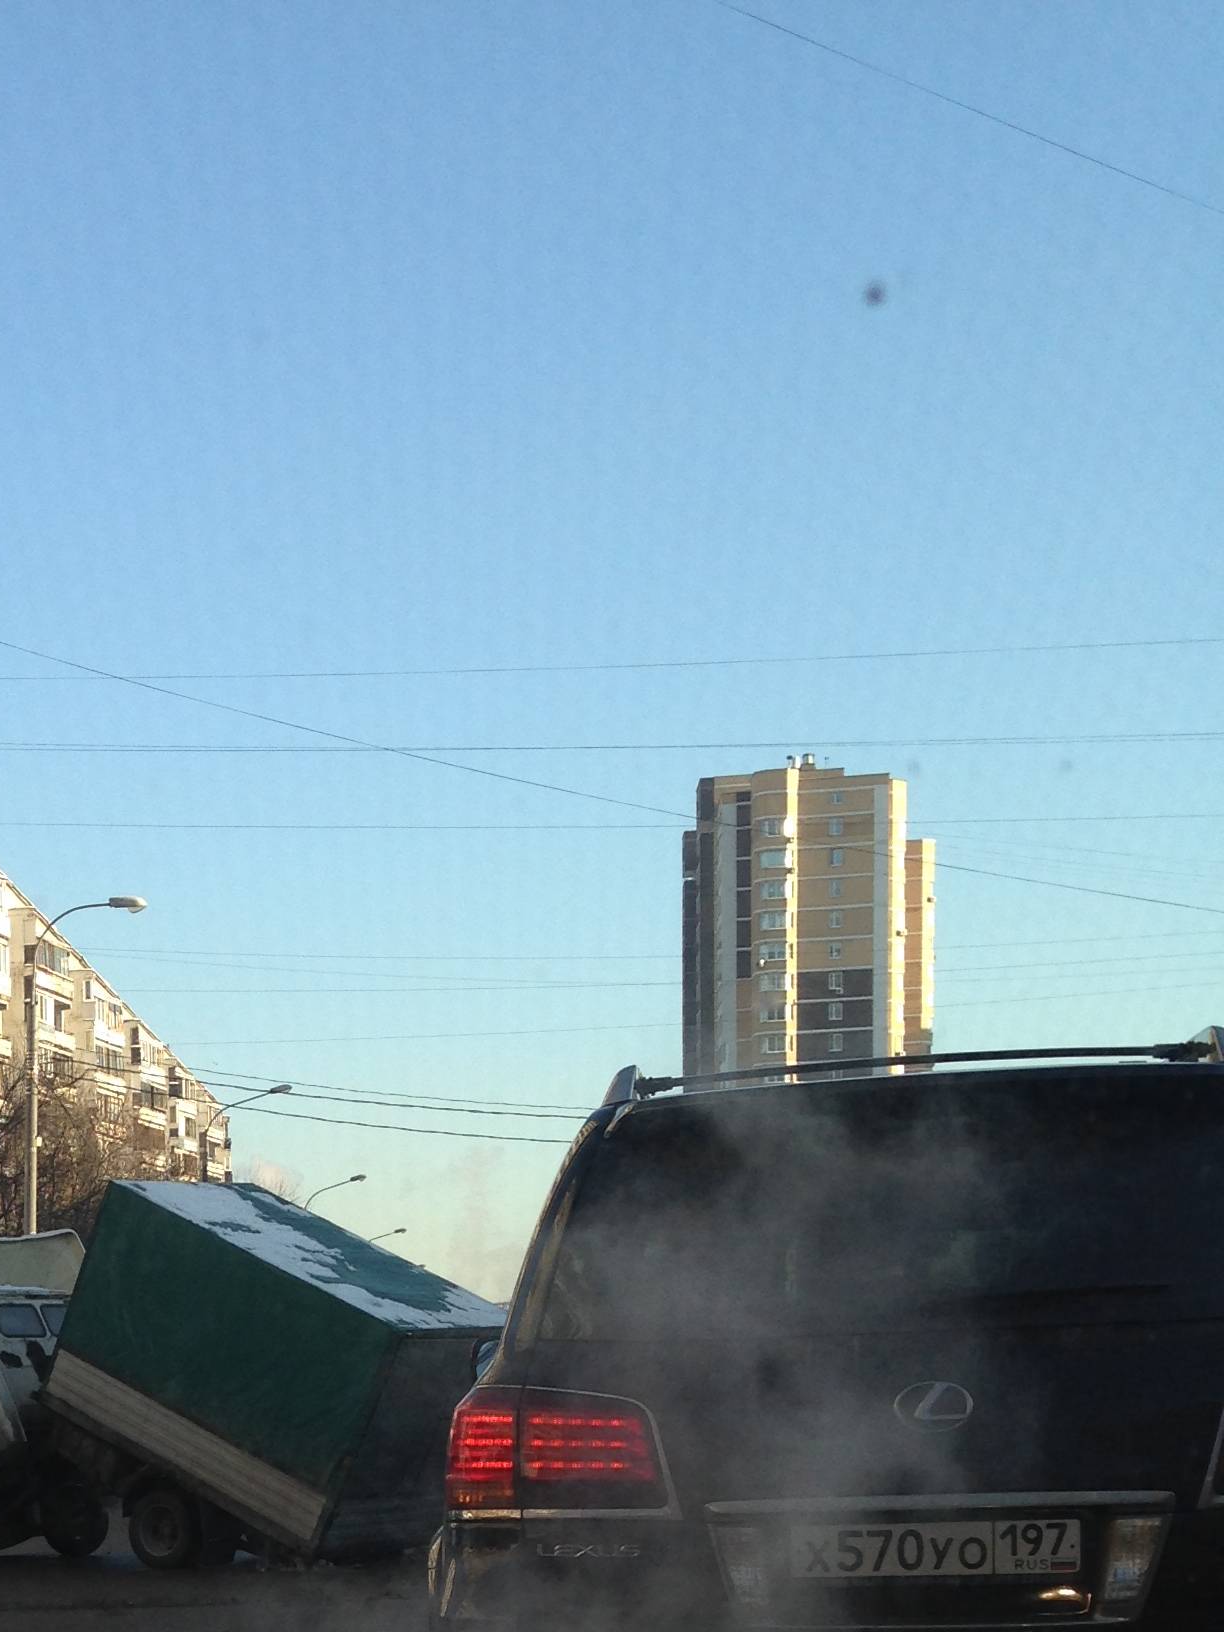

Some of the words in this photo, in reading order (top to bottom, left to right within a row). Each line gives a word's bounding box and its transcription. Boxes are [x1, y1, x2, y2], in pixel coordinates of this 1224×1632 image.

[999, 1523, 1069, 1557] 197
[536, 1543, 641, 1558] LEXUS
[1014, 1558, 1050, 1571] RUS
